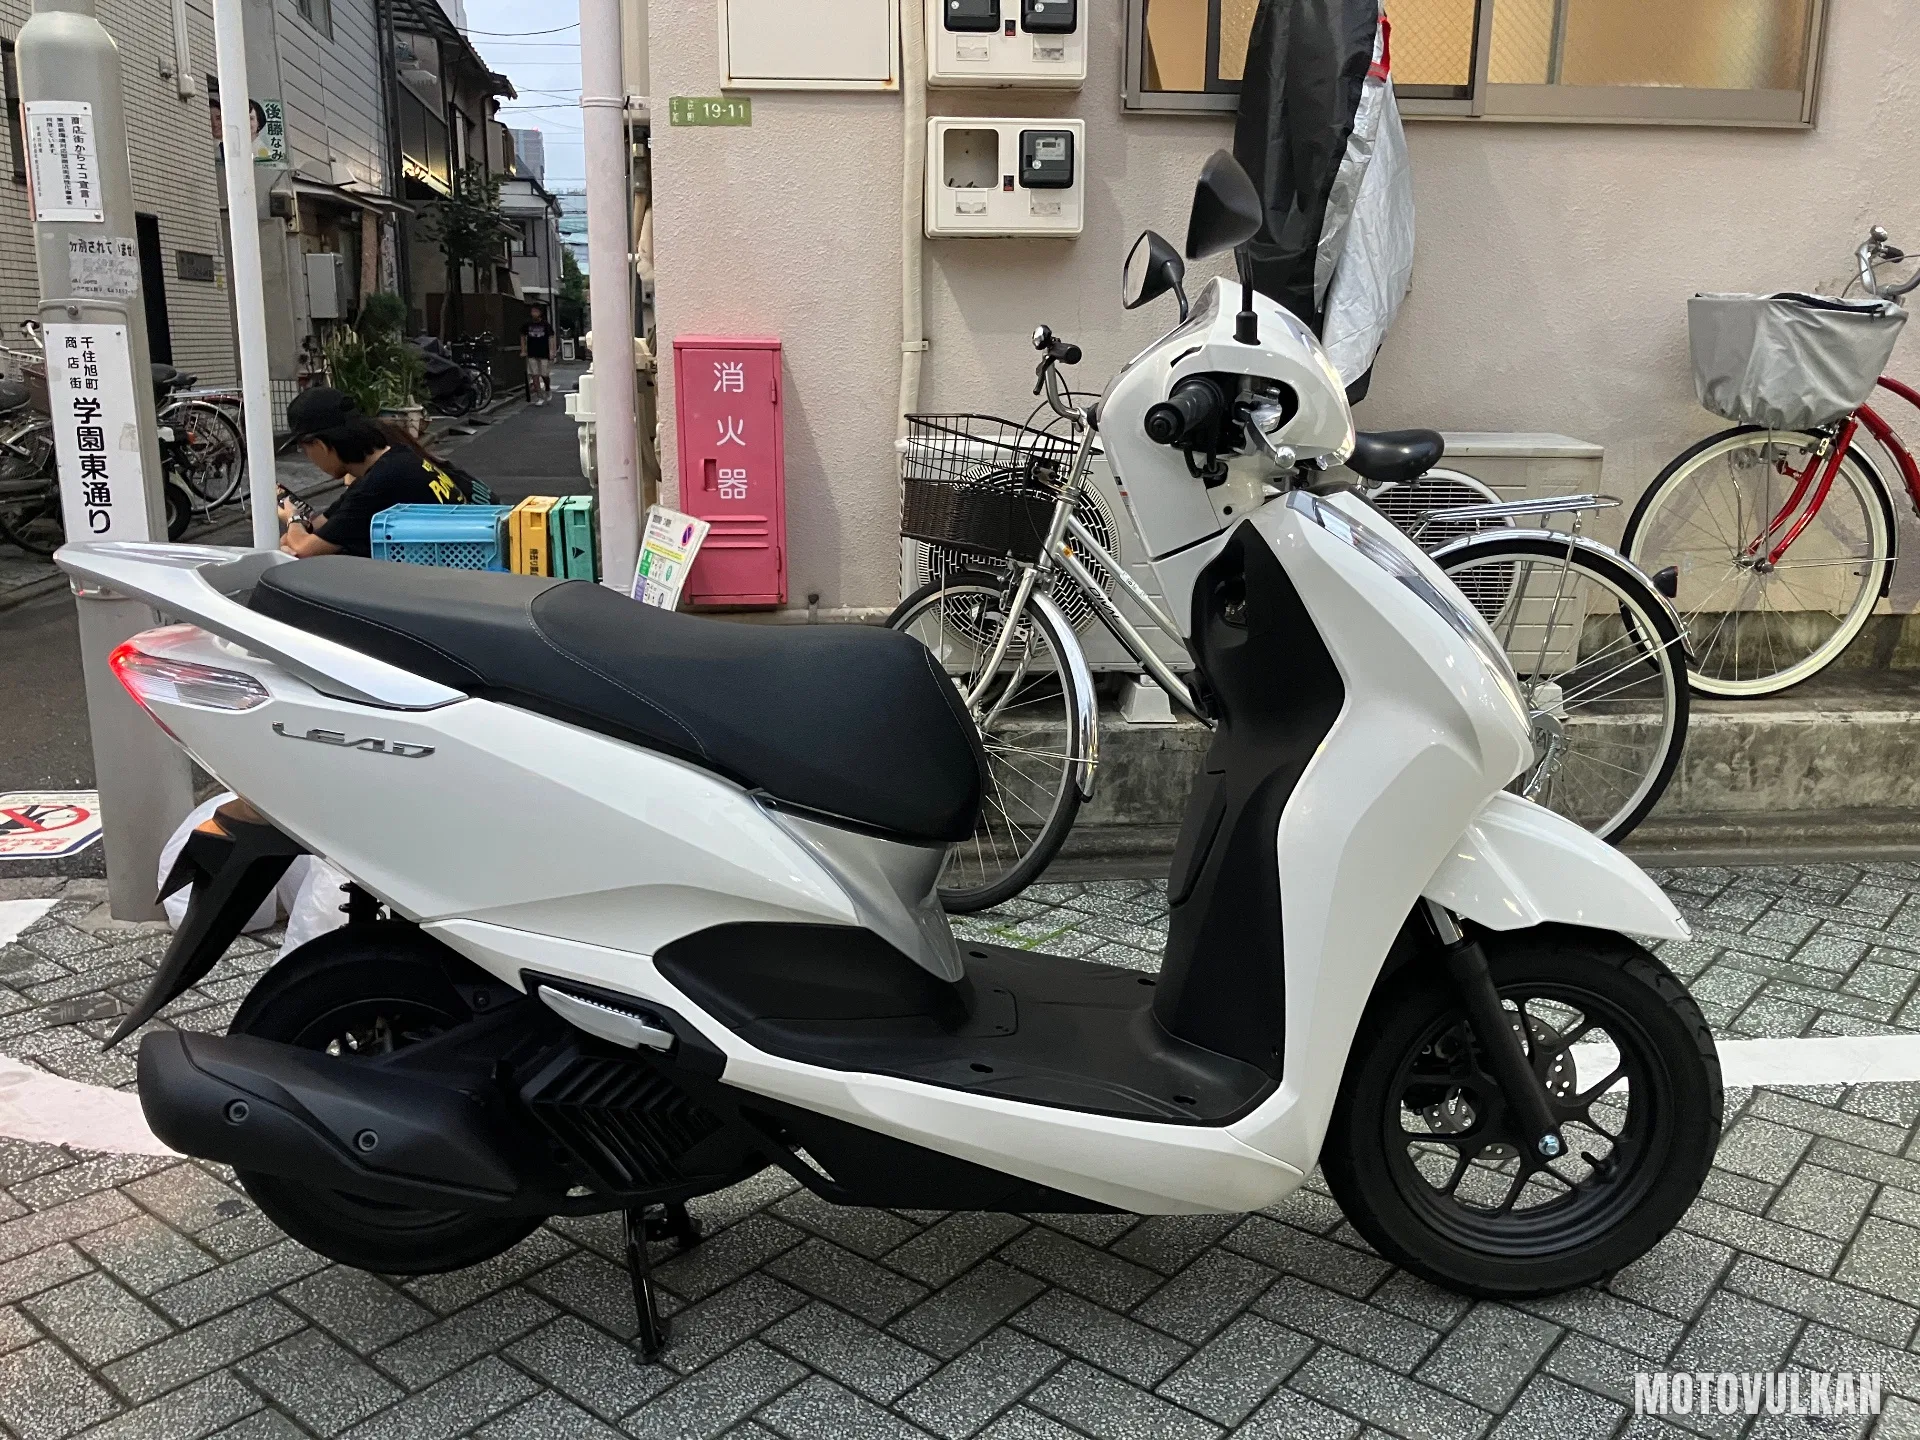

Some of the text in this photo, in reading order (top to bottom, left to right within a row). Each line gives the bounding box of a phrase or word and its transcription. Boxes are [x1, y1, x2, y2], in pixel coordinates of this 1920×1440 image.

[265, 103, 283, 160] 後藤なみ
[703, 102, 744, 118] 19-11
[65, 336, 82, 389] 商店街
[80, 336, 98, 391] 千住旭町
[713, 361, 748, 500] 消火器
[73, 397, 112, 534] 学園東通り
[272, 721, 436, 758] LEAD
